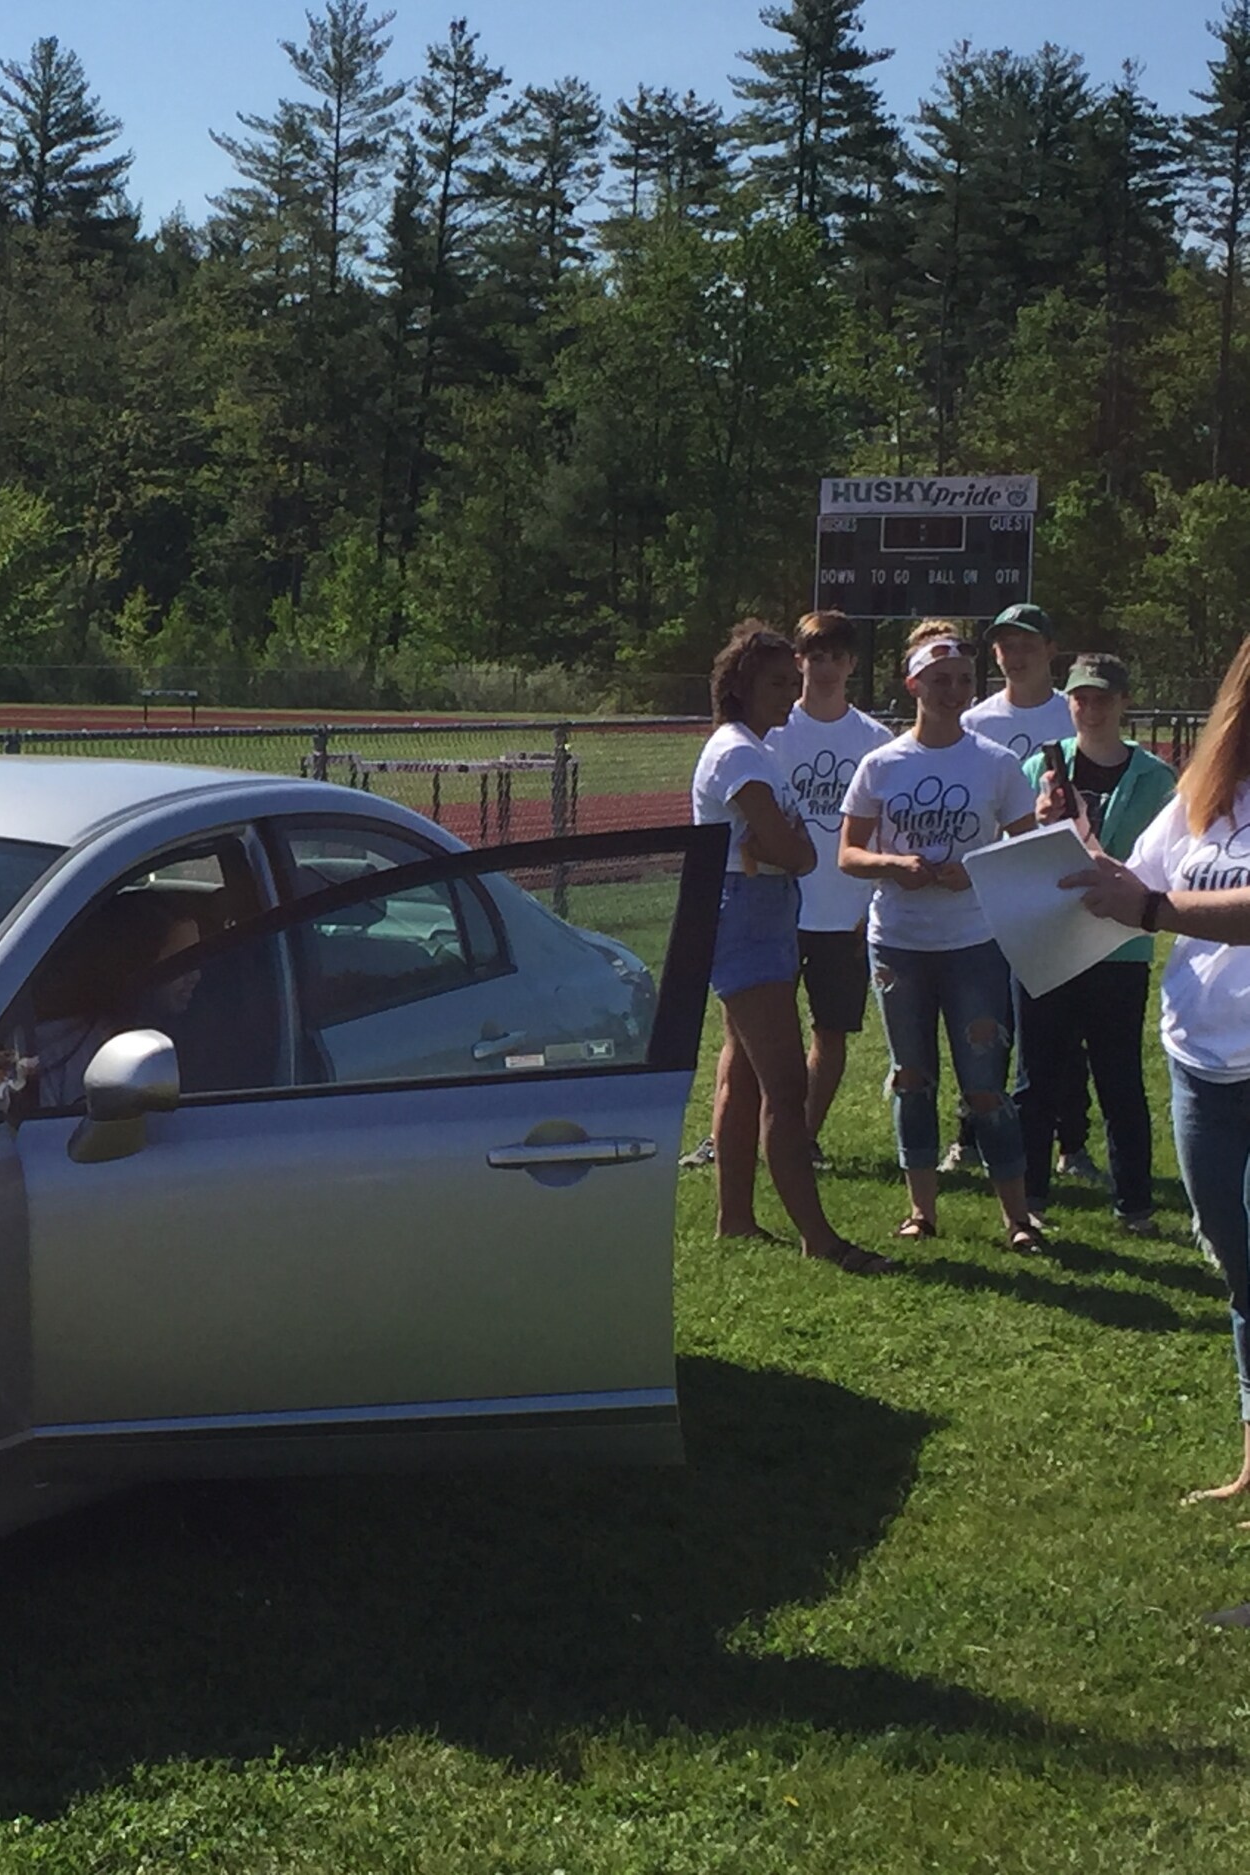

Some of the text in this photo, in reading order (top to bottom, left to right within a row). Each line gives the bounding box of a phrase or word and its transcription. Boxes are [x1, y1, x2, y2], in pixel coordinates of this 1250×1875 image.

[831, 481, 936, 503] HUSKY
[990, 514, 1030, 532] GUEST
[820, 569, 855, 584] DOWN
[871, 569, 910, 584] TO GO
[928, 569, 978, 584] BALL ON
